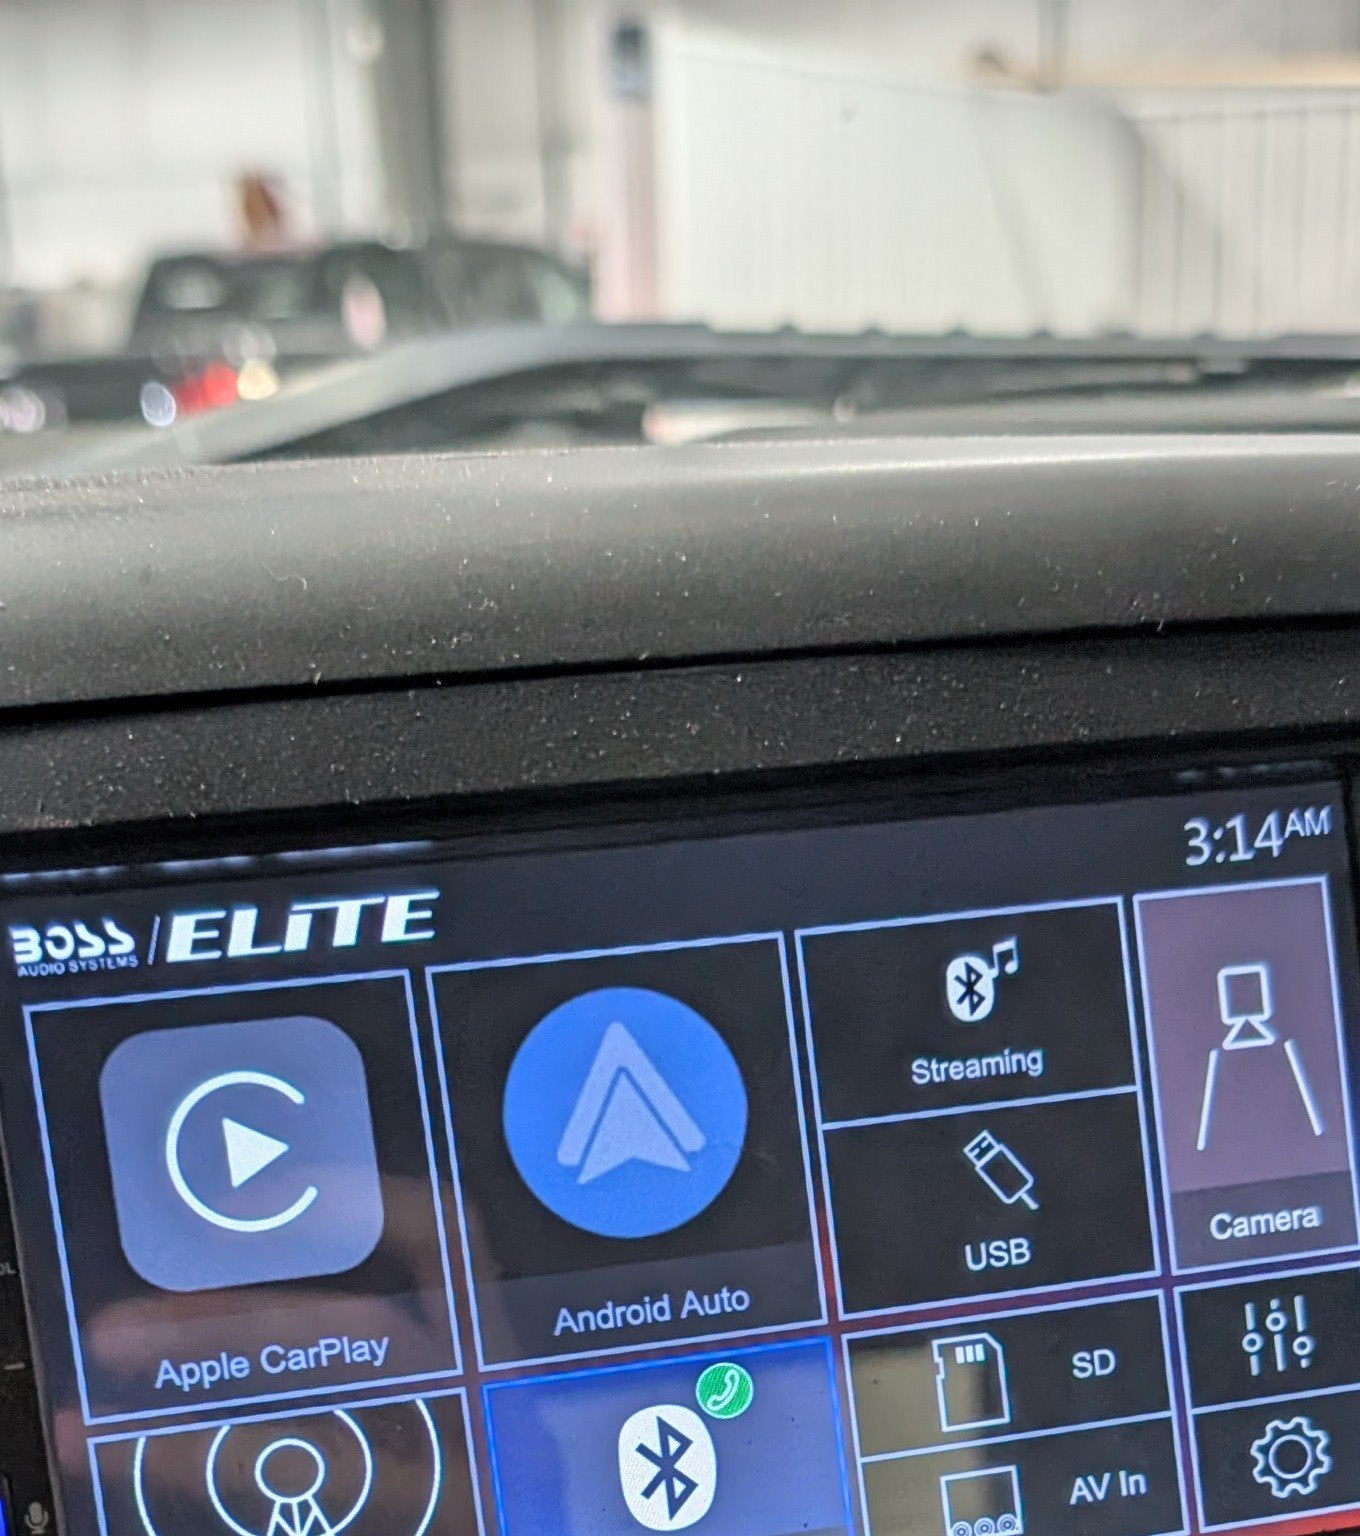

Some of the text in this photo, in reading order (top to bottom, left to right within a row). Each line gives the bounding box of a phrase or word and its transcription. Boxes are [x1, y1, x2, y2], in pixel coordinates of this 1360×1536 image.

[8, 917, 135, 963] BOSS
[17, 953, 139, 977] AUDIO SYSTEMS
[911, 1049, 1044, 1086] Streaming
[1210, 1206, 1321, 1241] Camera
[965, 1239, 1032, 1272] USB
[553, 1286, 751, 1337] Android Auto
[154, 1336, 389, 1392] Apple CarPlay
[1071, 1350, 1116, 1378] SD
[1069, 1471, 1148, 1505] AV In
